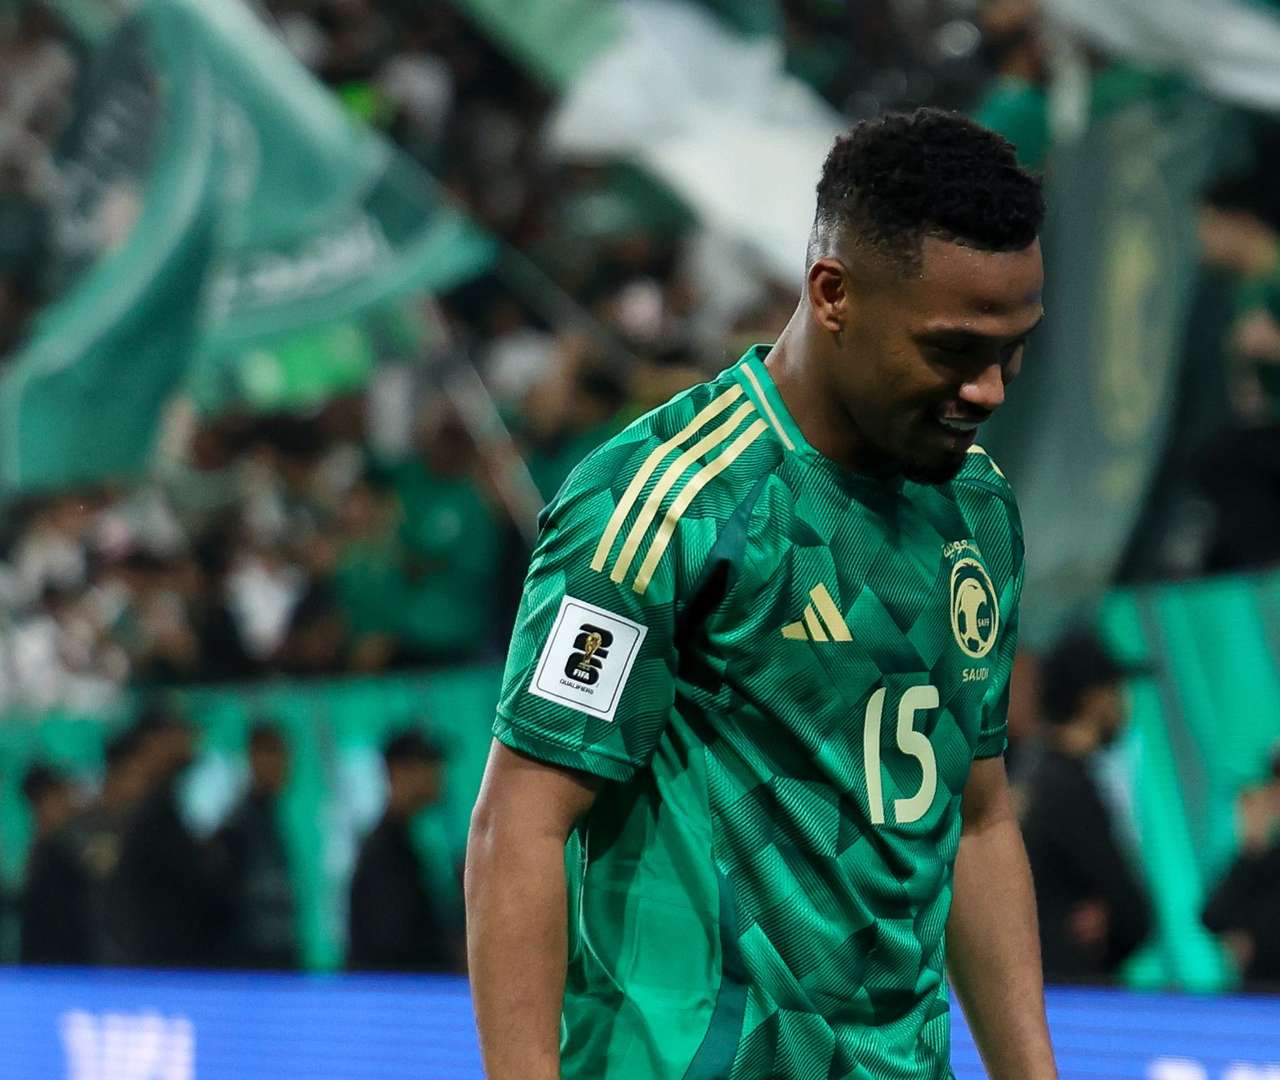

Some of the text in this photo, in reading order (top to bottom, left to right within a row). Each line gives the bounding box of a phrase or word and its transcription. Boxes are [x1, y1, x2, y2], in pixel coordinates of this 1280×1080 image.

[572, 668, 590, 680] FIFA
[961, 667, 990, 682] SAUDI
[863, 685, 940, 825] 15
